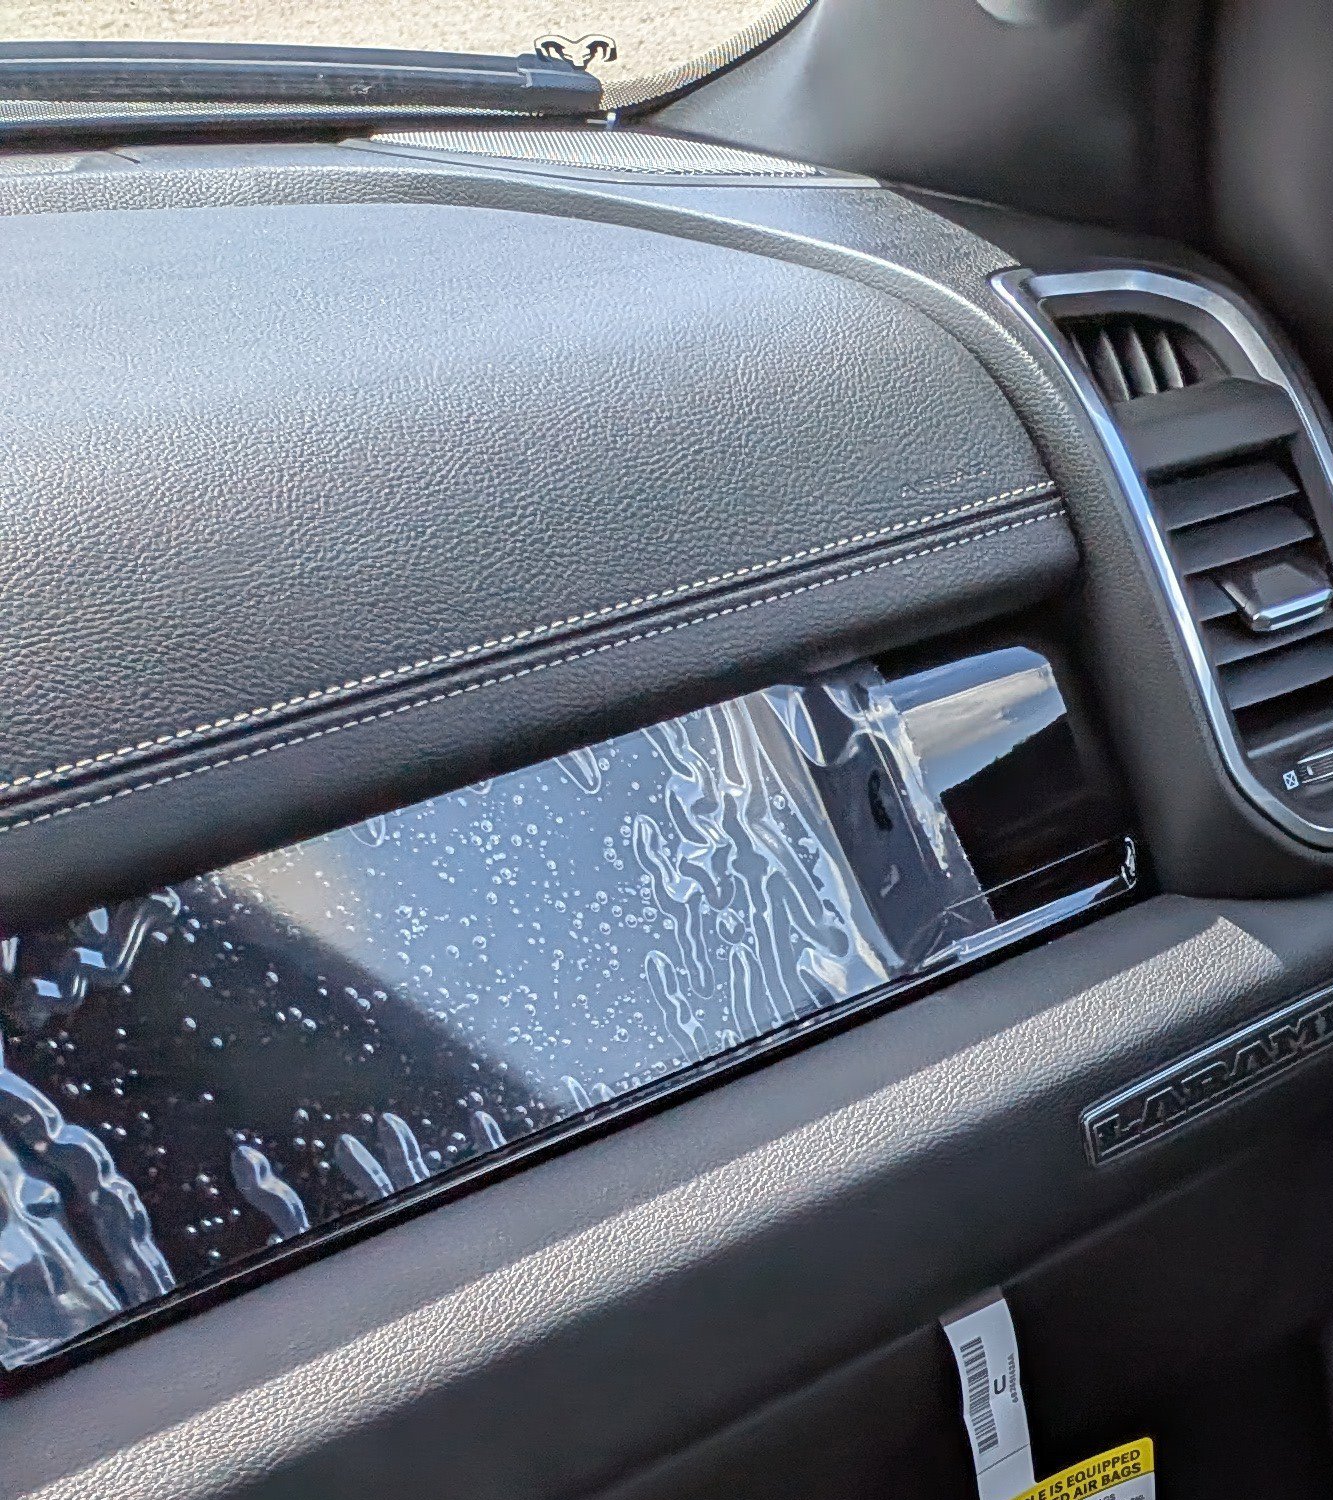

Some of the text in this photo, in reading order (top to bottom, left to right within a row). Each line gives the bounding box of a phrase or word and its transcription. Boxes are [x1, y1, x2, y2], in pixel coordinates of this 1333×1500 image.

[1050, 1481, 1063, 1497] IS
[1067, 1450, 1140, 1488] EQUIPPED
[1073, 1479, 1097, 1499] AIR
[1101, 1462, 1141, 1486] BAGS
